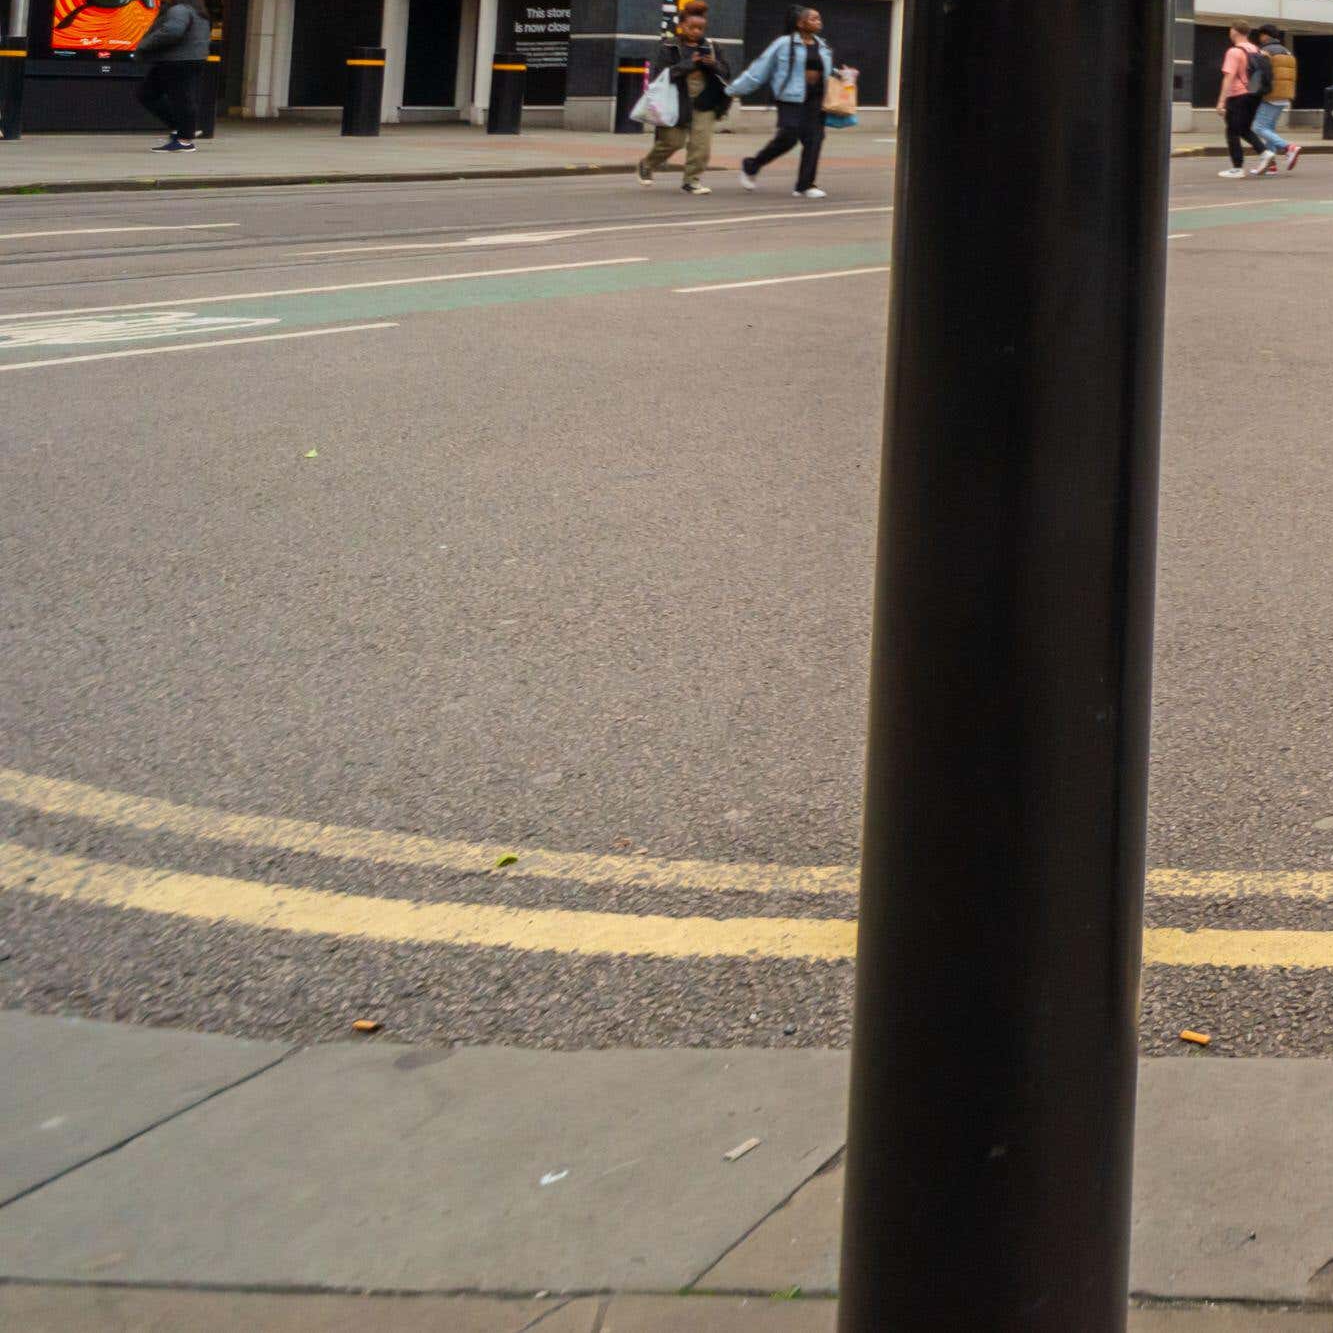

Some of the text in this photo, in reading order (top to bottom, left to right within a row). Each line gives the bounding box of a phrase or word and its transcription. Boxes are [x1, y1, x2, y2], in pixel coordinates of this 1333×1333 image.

[526, 8, 571, 18] This store
[515, 22, 571, 33] is now close
